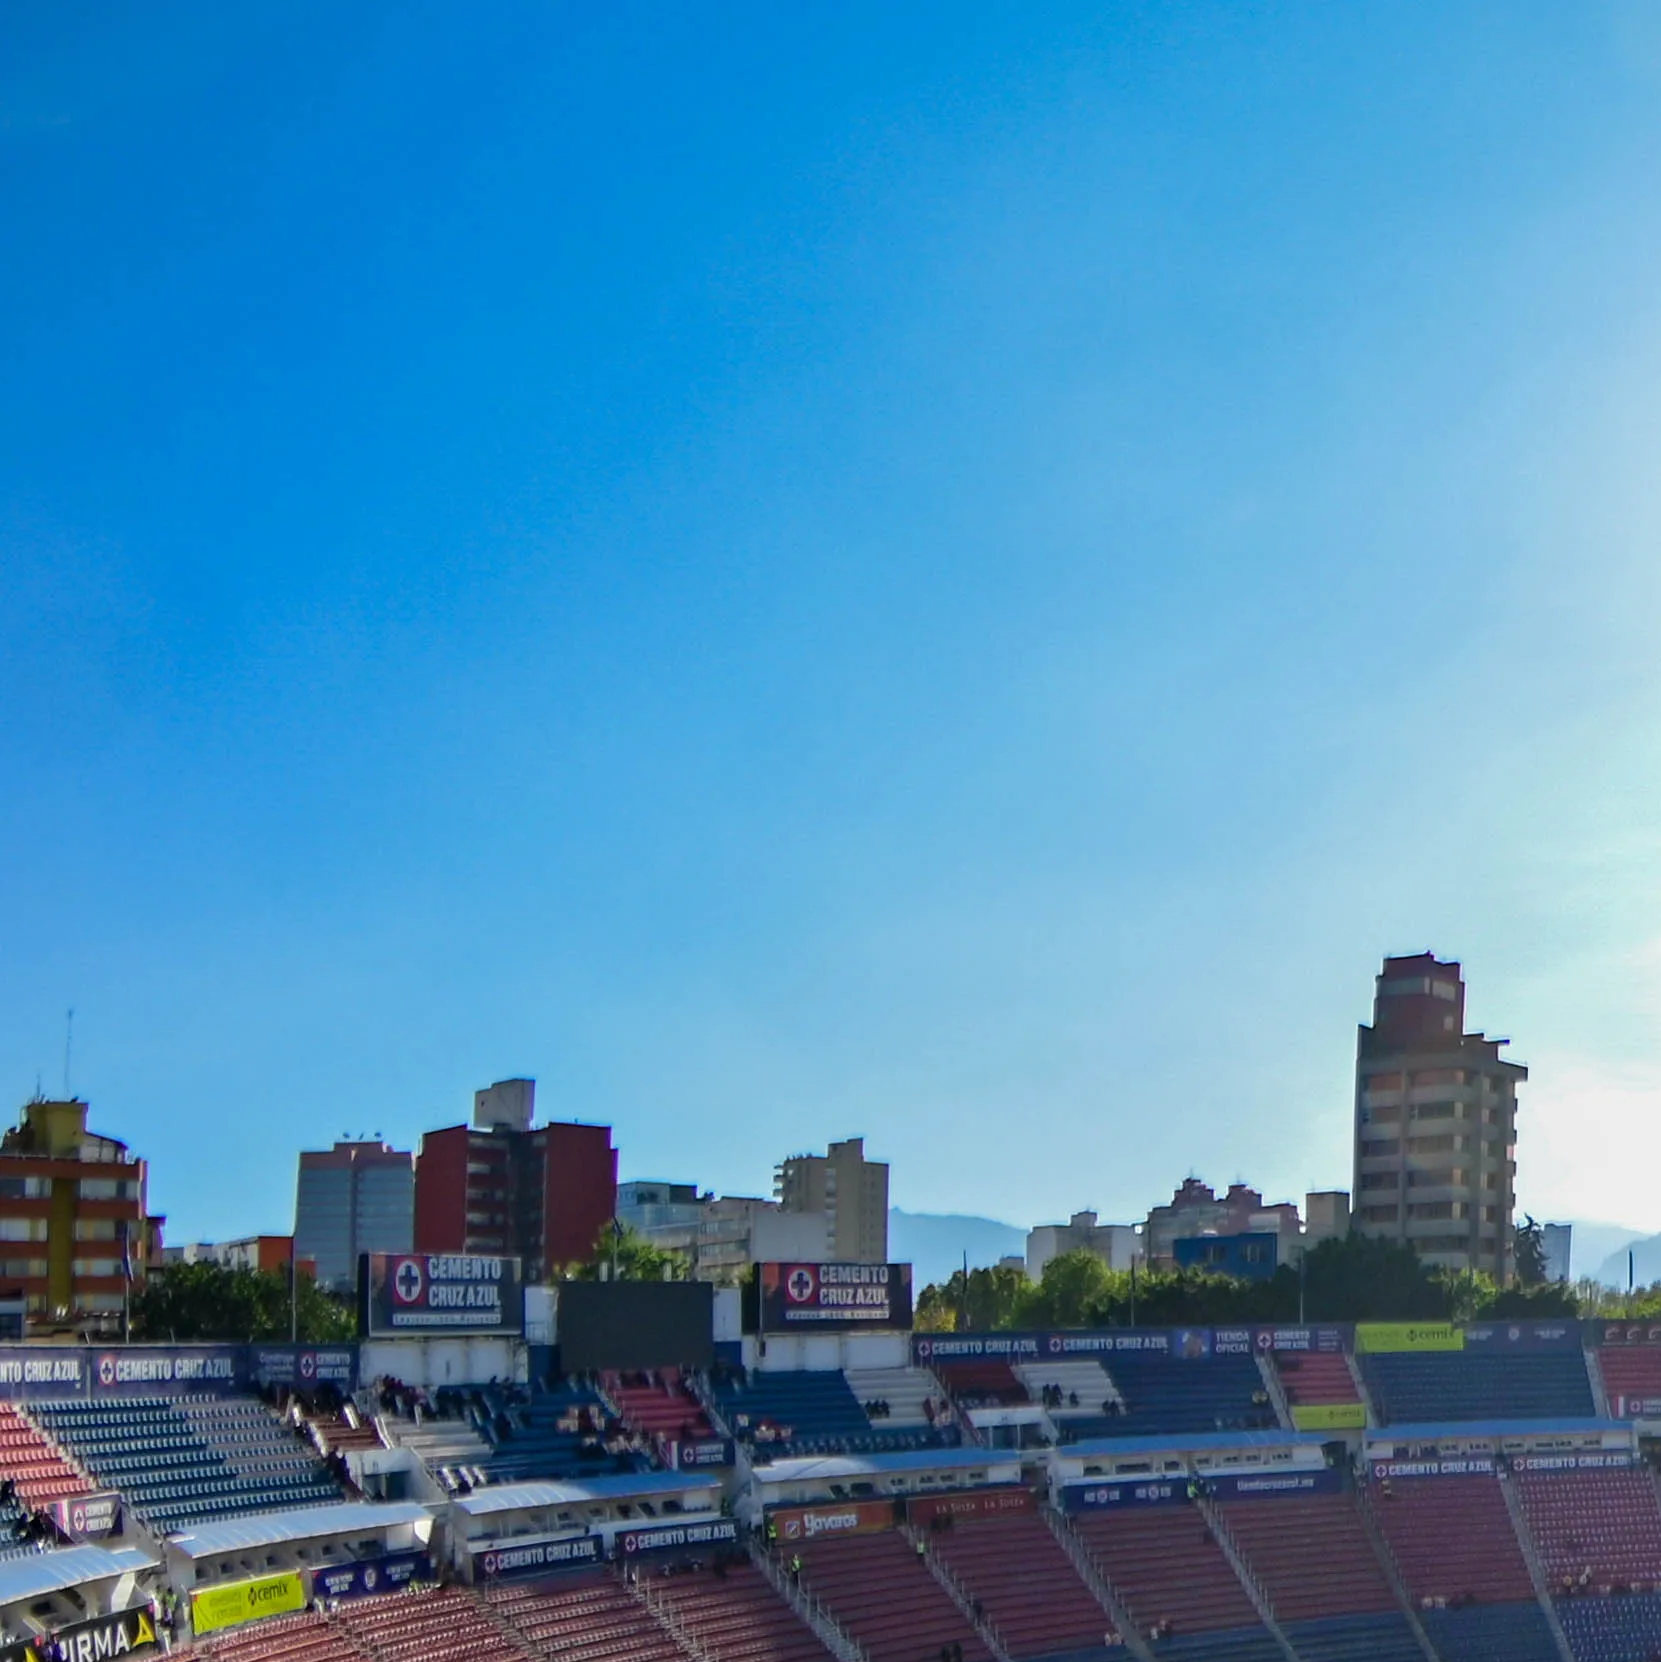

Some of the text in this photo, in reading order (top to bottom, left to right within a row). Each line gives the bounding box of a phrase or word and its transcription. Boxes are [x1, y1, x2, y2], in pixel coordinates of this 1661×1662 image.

[428, 1257, 501, 1279] CEMENTO
[820, 1265, 889, 1284] CEMENTO
[429, 1285, 501, 1307] CRUZ AZUL
[820, 1287, 890, 1305] CRUZ AZUL
[932, 1339, 1038, 1355] CEMENTO CRUZ AZUL
[1063, 1335, 1168, 1350] CEMENTO CRUZ AZUL
[116, 1359, 171, 1382] CEMENTO
[175, 1357, 205, 1380] CRUZ
[205, 1356, 235, 1379] AZUL
[638, 1523, 737, 1550] CEMENTO CRUZ AZUL
[258, 1581, 289, 1601] cemix
